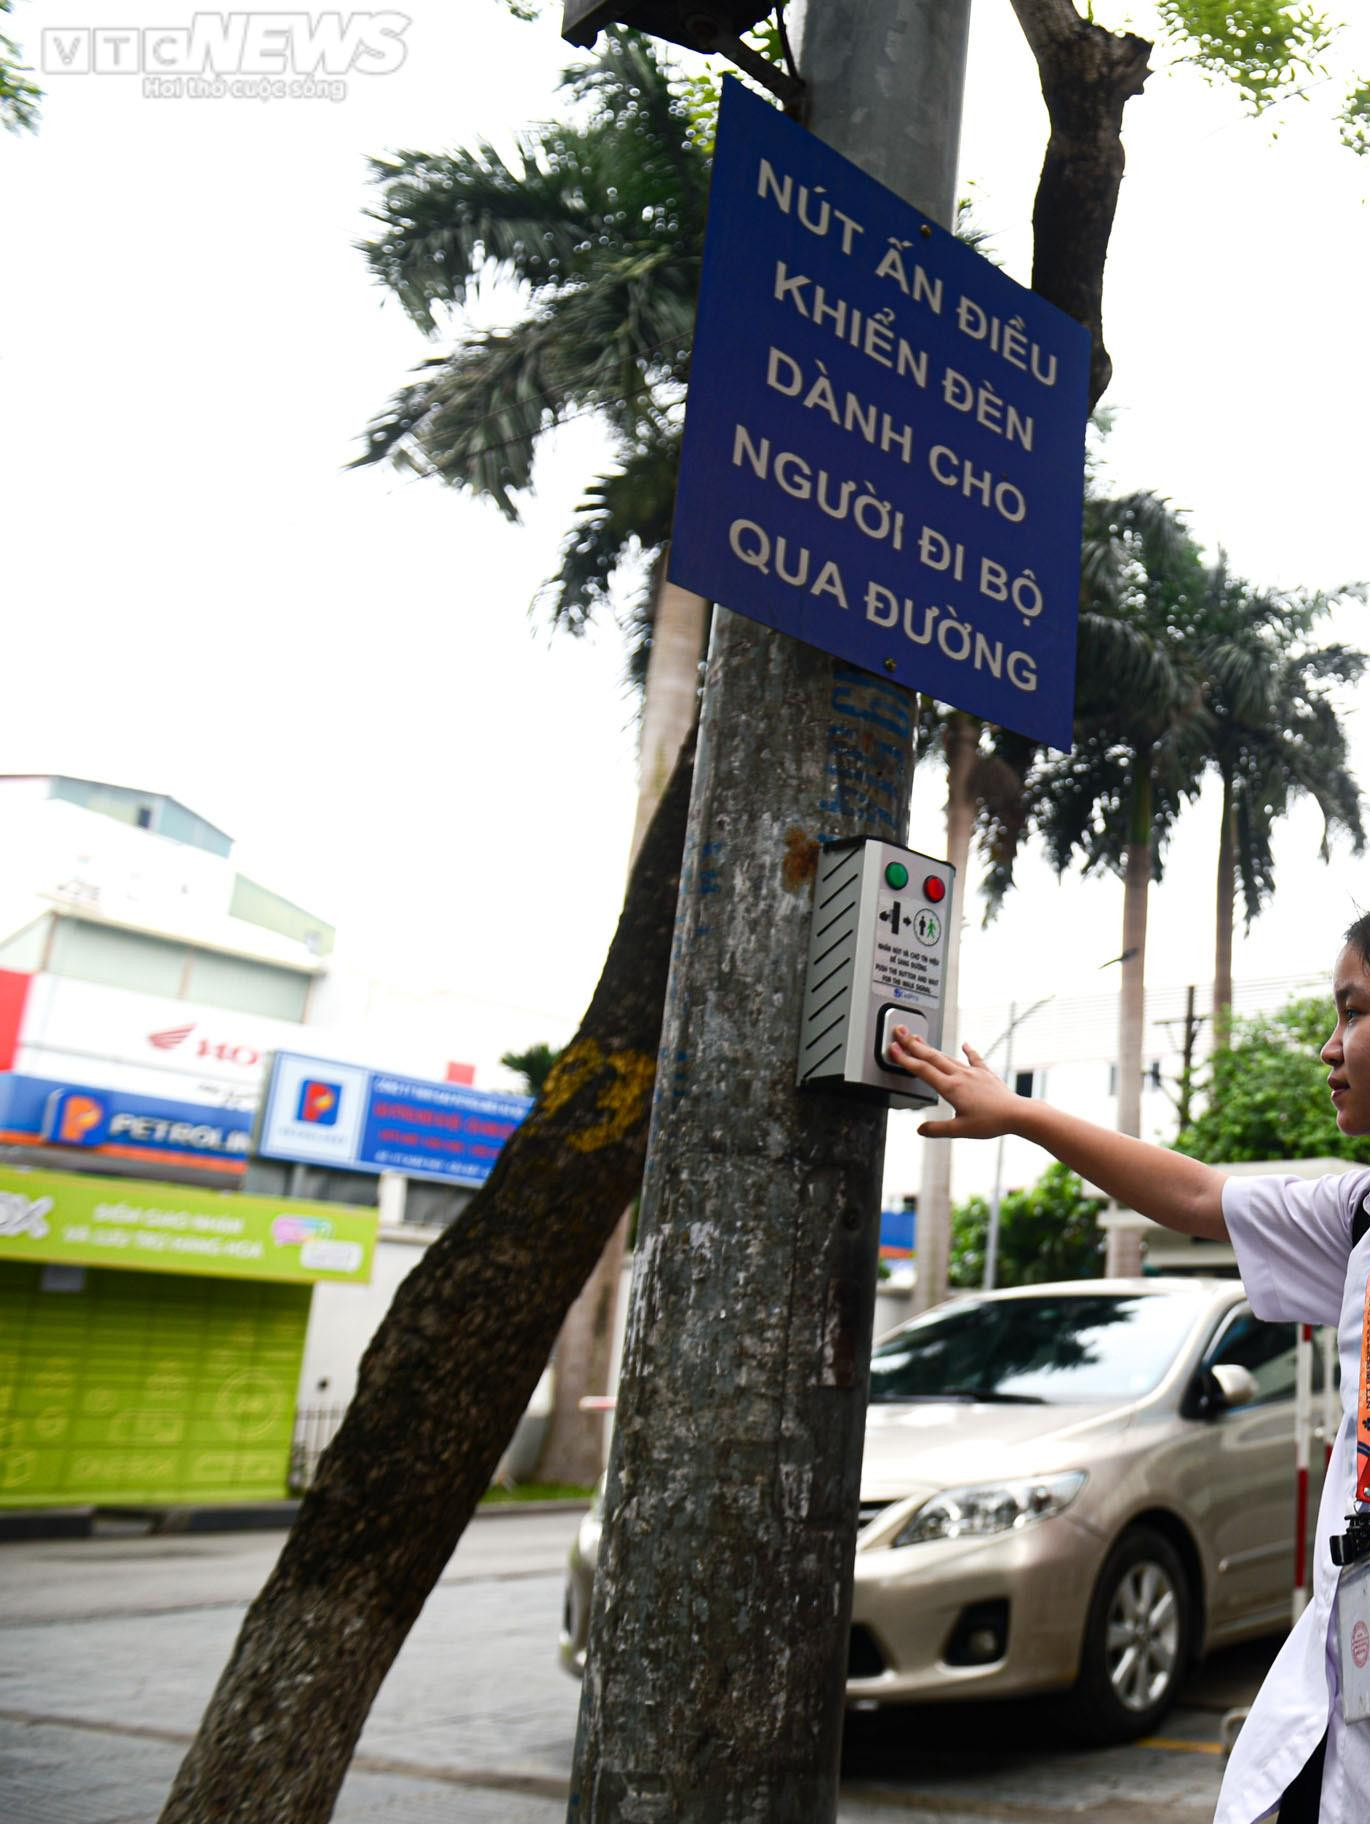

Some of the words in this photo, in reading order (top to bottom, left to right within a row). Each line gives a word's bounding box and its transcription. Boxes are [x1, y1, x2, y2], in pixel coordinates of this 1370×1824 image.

[757, 157, 864, 255] NÚT
[875, 237, 942, 314] ẤN
[957, 296, 1057, 386] ĐIỀU
[774, 260, 928, 387] KHIỂN
[942, 367, 1033, 452] ĐÈN
[732, 424, 904, 550] NGƯỜI
[918, 526, 963, 581] ĐI
[979, 557, 1043, 627] BỘ
[766, 346, 912, 463] DÀNH
[928, 445, 1026, 523] CHO
[729, 519, 848, 608] QUA
[864, 581, 1037, 692] ĐƯỜNG
[875, 963, 888, 971] PUSH
[889, 967, 897, 975] THE
[899, 970, 916, 980] BUTTON
[917, 975, 927, 983] AND
